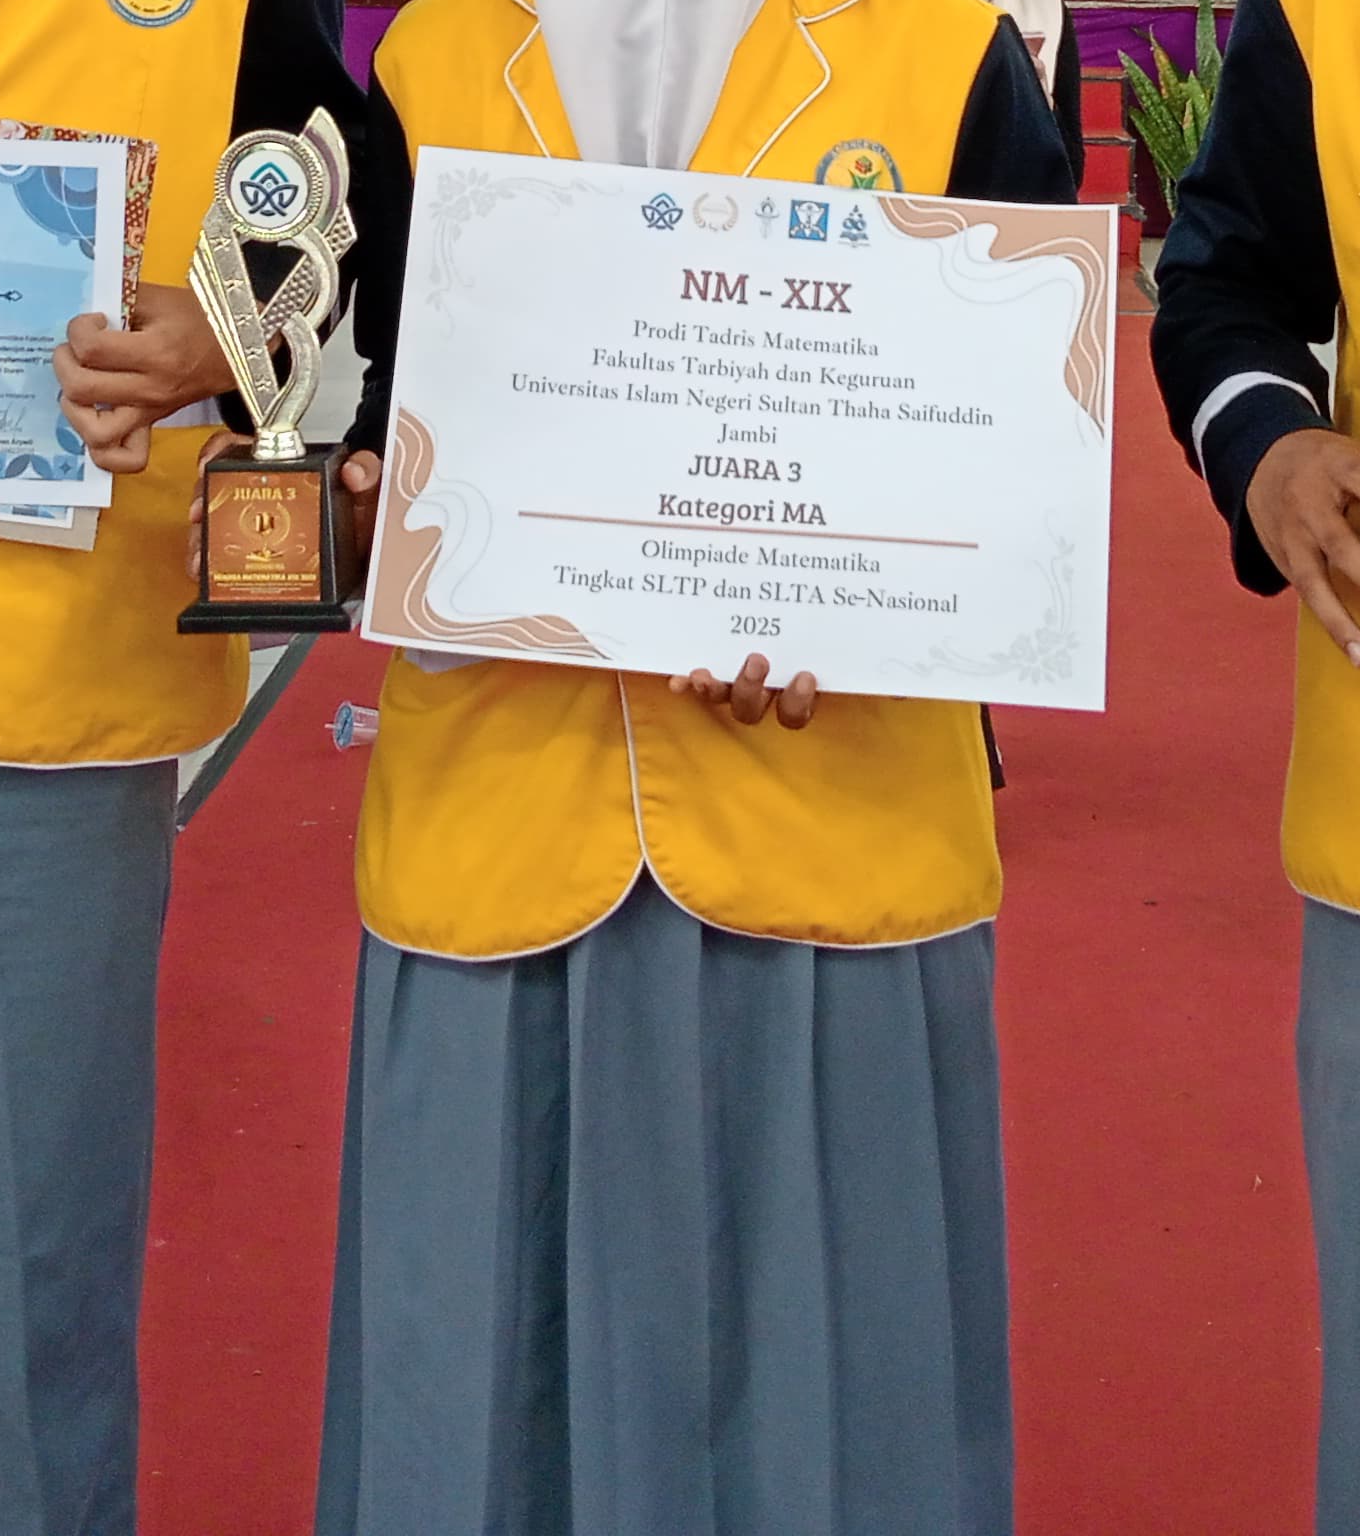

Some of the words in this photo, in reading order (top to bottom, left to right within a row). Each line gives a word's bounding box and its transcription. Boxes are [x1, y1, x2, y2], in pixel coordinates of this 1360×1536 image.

[680, 268, 750, 306] NM
[759, 289, 773, 297] -
[781, 278, 853, 314] XIX
[633, 320, 687, 341] Prodi
[693, 325, 756, 347] Tadris
[762, 331, 879, 356] Matematika
[592, 348, 676, 372] Fakultas
[681, 356, 769, 383] Tarbiyah
[776, 364, 812, 384] dan
[819, 367, 916, 392] Keguruan
[511, 373, 619, 400] Universitas
[625, 383, 679, 405] Islam
[686, 388, 752, 414] Negeri
[758, 394, 822, 416] Sultan
[827, 398, 892, 420] Thaha
[897, 403, 994, 427] Saifuddin
[717, 423, 777, 445] Jambi
[688, 455, 781, 481] JUARA
[787, 462, 802, 483] 3
[233, 487, 283, 501] JUARA
[286, 487, 297, 500] 3
[658, 493, 776, 526] Kategori
[781, 501, 827, 526] MA
[641, 539, 749, 568] Olimpiade
[757, 546, 881, 574] Matematika
[554, 565, 634, 593] Tingkat
[641, 573, 707, 596] SLTP
[713, 579, 751, 600] dan
[759, 581, 826, 605] SLTA
[833, 586, 959, 613] Se-Nasional
[730, 614, 781, 636] 2025
